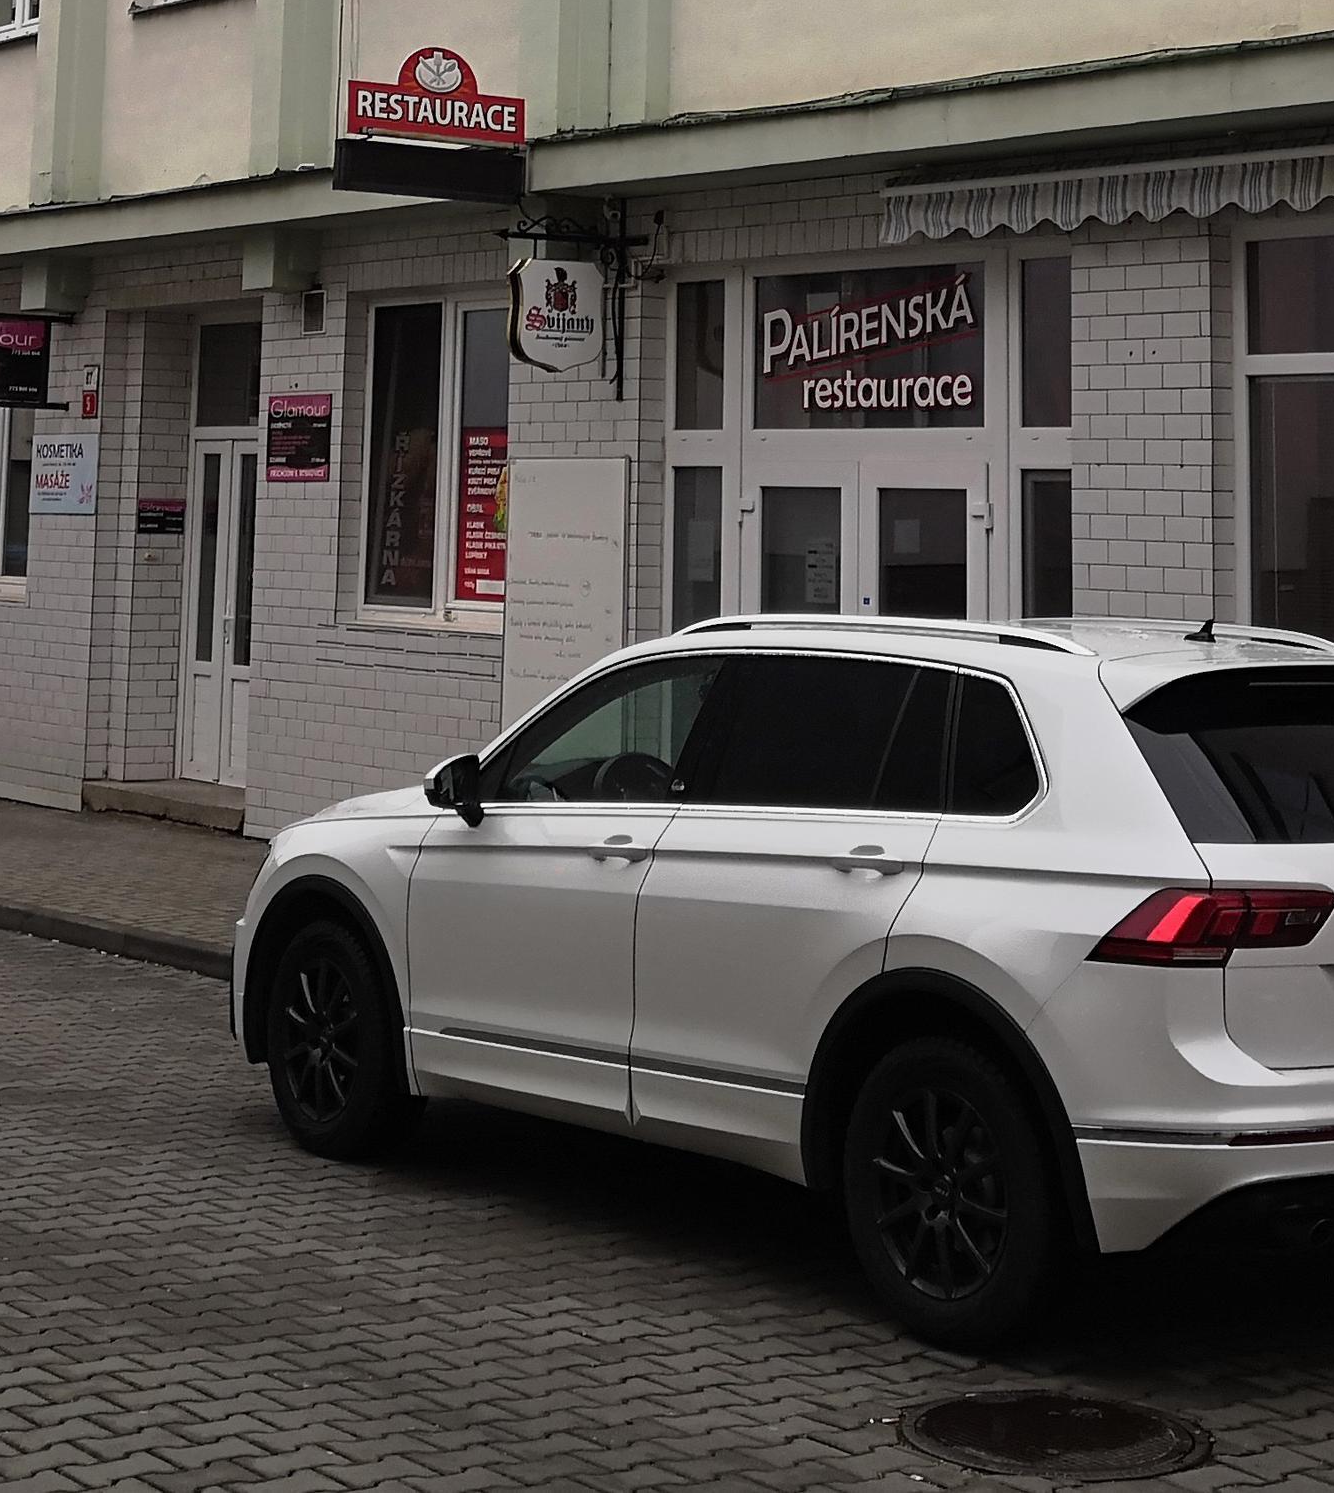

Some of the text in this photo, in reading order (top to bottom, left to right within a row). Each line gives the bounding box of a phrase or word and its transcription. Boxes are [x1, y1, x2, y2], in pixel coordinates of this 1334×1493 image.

[357, 89, 517, 132] RESTAURACE
[525, 306, 594, 335] Svijany
[762, 272, 976, 375] PALÍRENSKÁ
[802, 370, 972, 409] restaurace
[270, 400, 327, 418] Glamour
[36, 443, 84, 459] KOSMETIKA
[35, 470, 70, 489] MASÁŽE
[381, 431, 411, 586] ŘÍZKÁRNA
